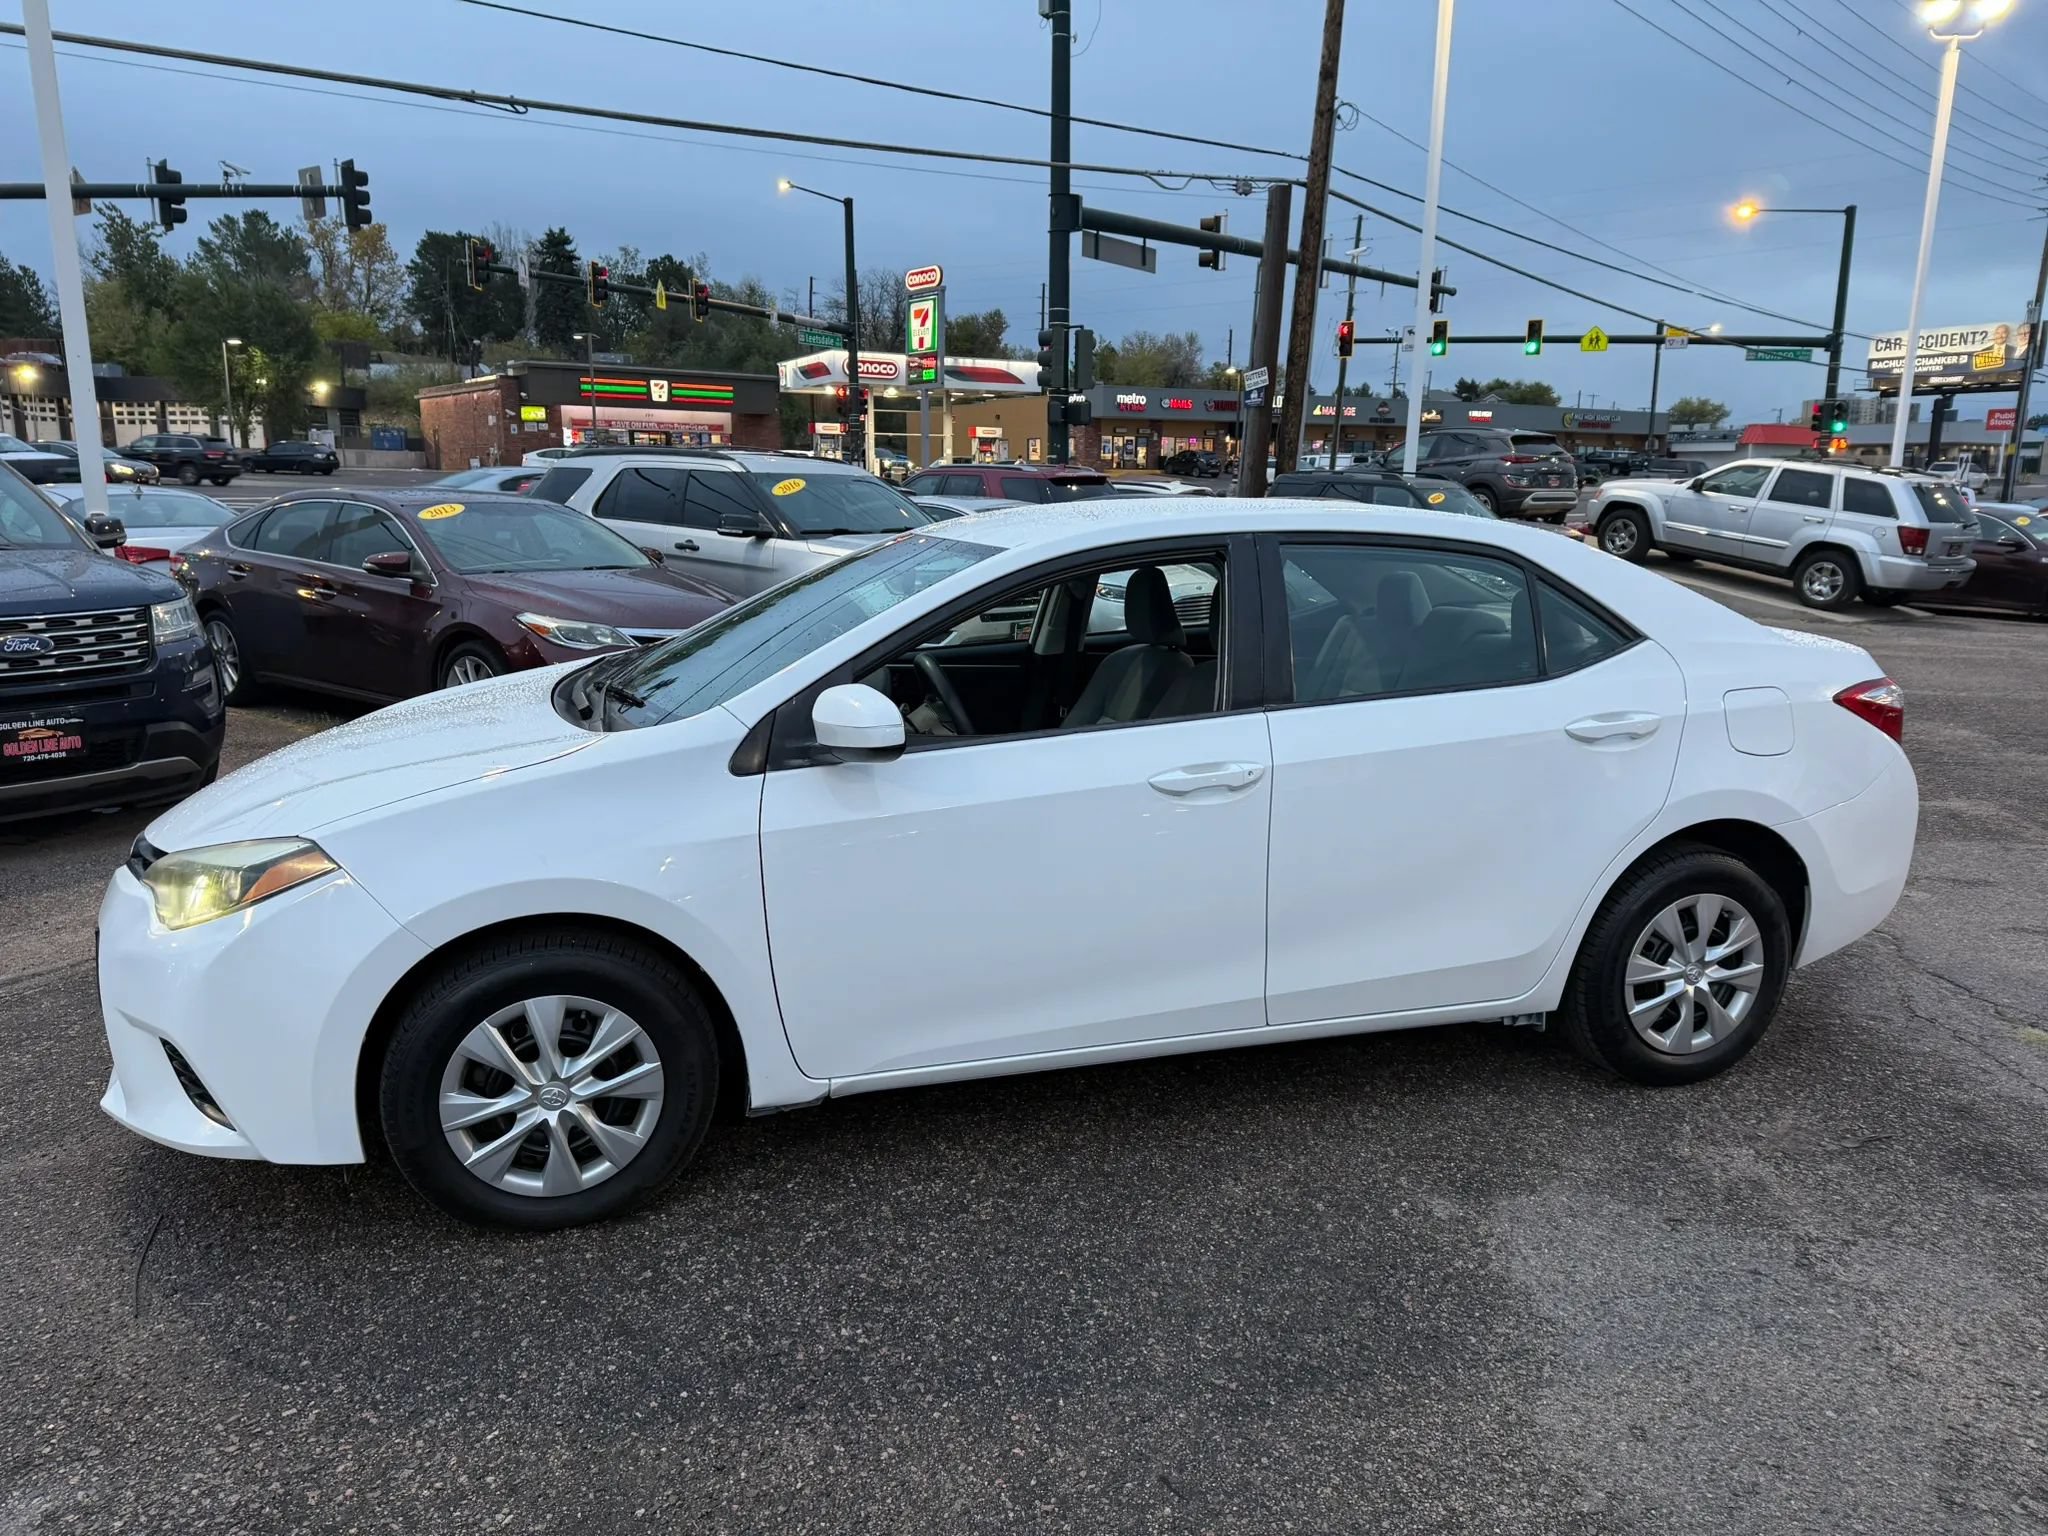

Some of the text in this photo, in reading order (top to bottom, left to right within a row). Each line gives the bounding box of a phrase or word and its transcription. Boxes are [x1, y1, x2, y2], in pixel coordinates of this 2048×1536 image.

[913, 307, 929, 349] 7
[1875, 330, 1989, 352] CAR CCIDENT?
[1914, 355, 1958, 366] CHANKER
[852, 362, 896, 375] onoco
[1914, 365, 1944, 373] LAWYERS
[1068, 394, 1086, 403] etro
[1116, 392, 1147, 405] metro
[1170, 398, 1193, 409] NAILS
[1995, 412, 2016, 420] Publi
[611, 420, 630, 429] SAVE
[631, 421, 642, 429] ON
[778, 480, 801, 494] 2016
[426, 504, 456, 518] 2013
[4, 637, 41, 652] Ford
[28, 718, 45, 728] LINE
[46, 717, 66, 727] AUTO
[3, 735, 82, 757] GOLDEN LINE AUTO
